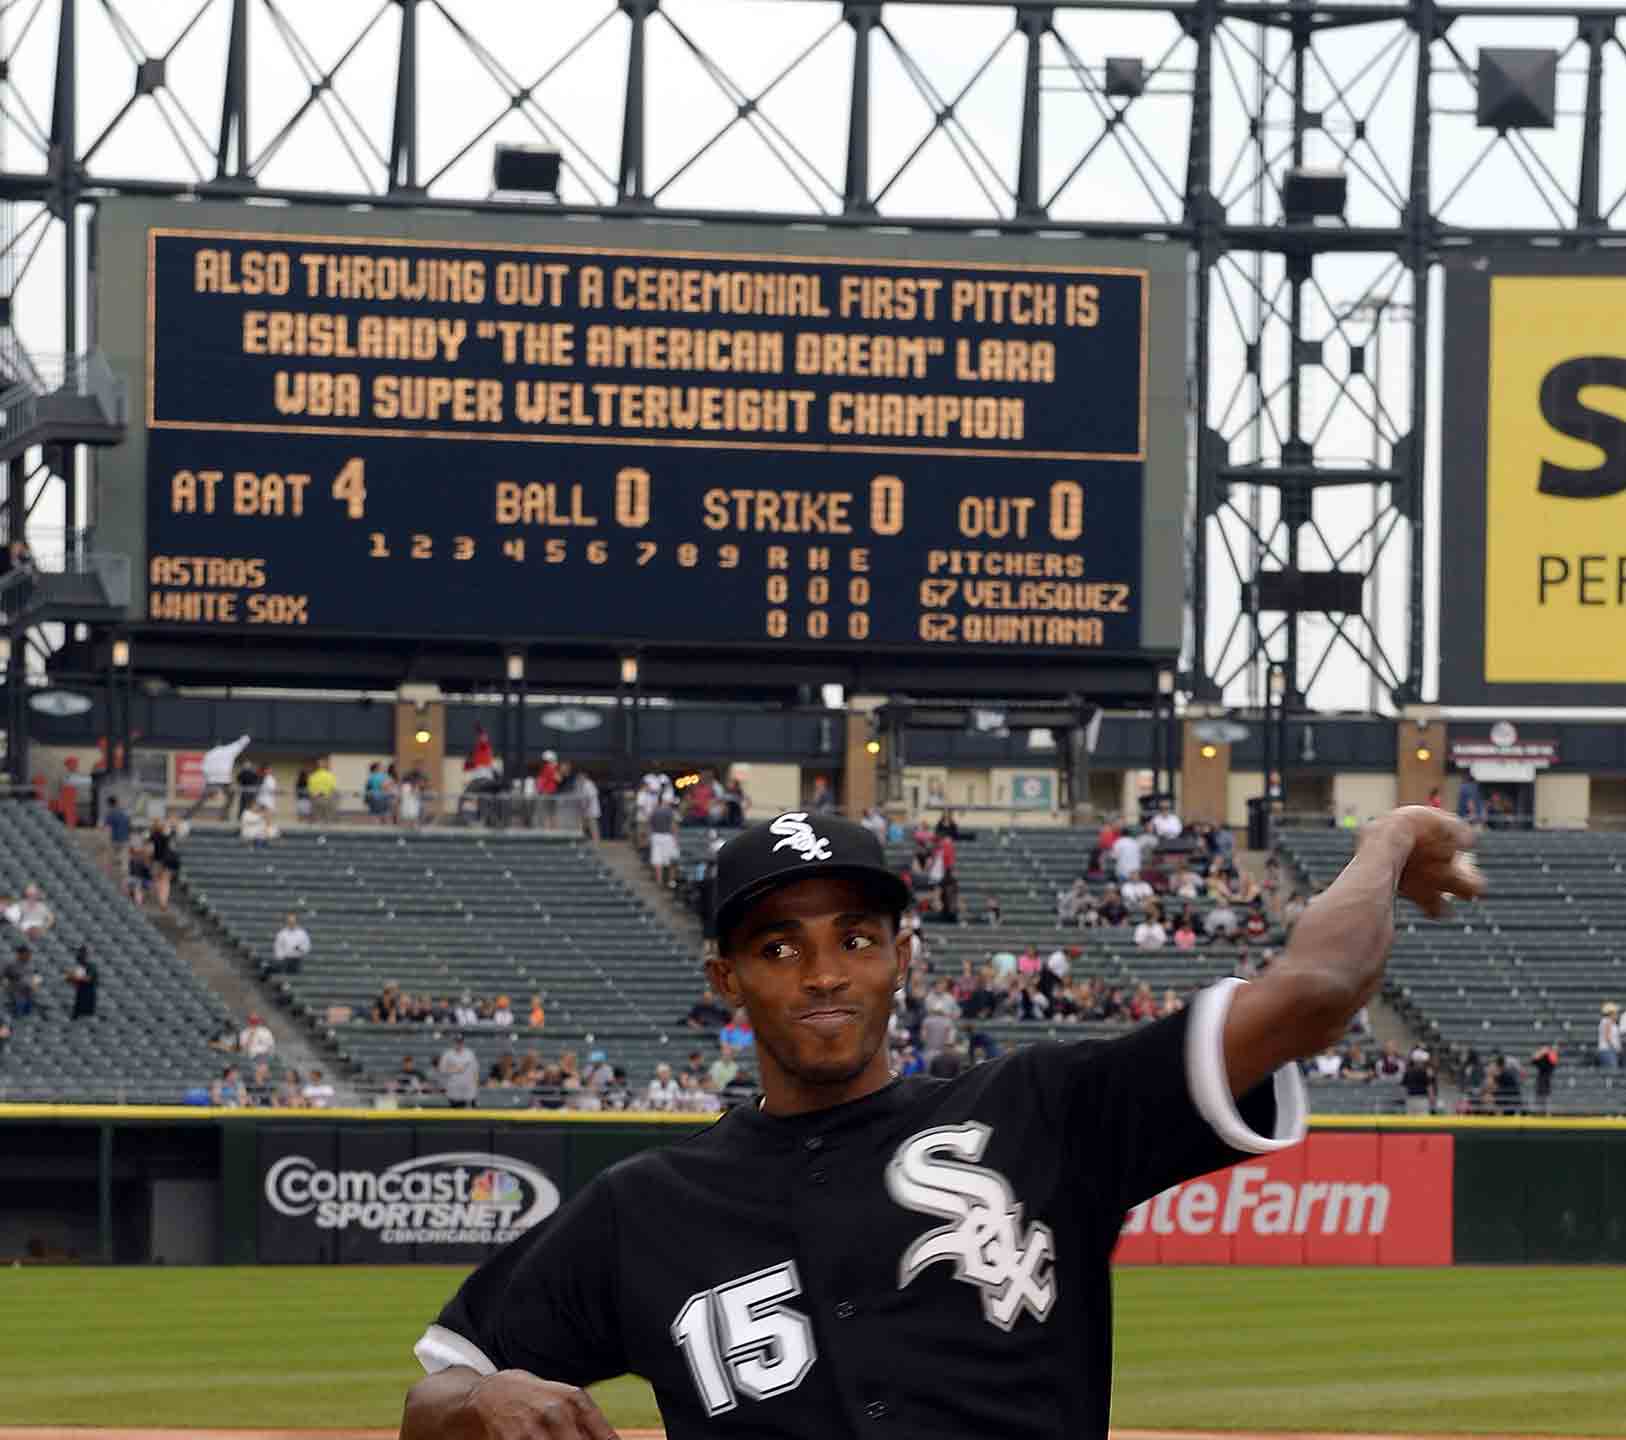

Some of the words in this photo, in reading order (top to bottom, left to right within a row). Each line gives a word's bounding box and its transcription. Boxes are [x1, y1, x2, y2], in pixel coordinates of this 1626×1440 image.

[195, 248, 290, 296] ALSO
[299, 253, 486, 304] THROWING
[495, 262, 570, 307] OUT
[579, 265, 604, 308] A
[613, 267, 831, 318] CEREMONIAL
[839, 276, 943, 321] FIRST
[951, 279, 1057, 325] PITCH
[1065, 284, 1100, 327] IS
[242, 311, 467, 362] ERISLANDY
[586, 324, 784, 374] AMERICAN
[956, 338, 1056, 383] LARA
[274, 371, 361, 417] WBA
[372, 375, 503, 423] SUPER
[514, 381, 816, 433] WELTERWEIGHT
[828, 391, 1025, 440] CHAMPION
[172, 470, 224, 513] AT
[233, 472, 311, 515] BAT
[332, 457, 367, 519] 4
[495, 481, 597, 526] BALL
[615, 467, 650, 528] 0
[703, 488, 852, 534] STRIKE
[870, 475, 904, 535] 0
[959, 496, 1035, 538] OUT
[1049, 480, 1083, 541] 0
[150, 556, 266, 588] ASTROS
[371, 533, 389, 557] 1
[411, 535, 433, 559] 2
[455, 536, 475, 561] 3
[503, 539, 525, 561] 4
[546, 539, 566, 563] 5
[587, 541, 607, 564] 6
[638, 542, 657, 566] 7
[677, 543, 698, 567] 8
[719, 544, 739, 568] 9
[767, 546, 788, 570] R
[808, 547, 829, 571] H
[850, 548, 869, 572] E
[928, 550, 1084, 576] PITCHERS
[767, 575, 788, 604] 0
[808, 576, 829, 604] 0
[849, 577, 870, 605] 0
[920, 578, 958, 607] 67
[963, 580, 1129, 612] VELASQUEZ
[1538, 555, 1626, 605] PE
[151, 591, 236, 622] WHITE
[247, 594, 308, 624] SOX
[767, 609, 788, 638] 0
[807, 611, 829, 638] 0
[849, 611, 869, 640] 0
[919, 613, 958, 641] 62
[962, 614, 1103, 645] QUINTANA
[265, 1156, 470, 1213] Comcast
[315, 1199, 521, 1229] SPORTSNET
[671, 1260, 817, 1418] 15
